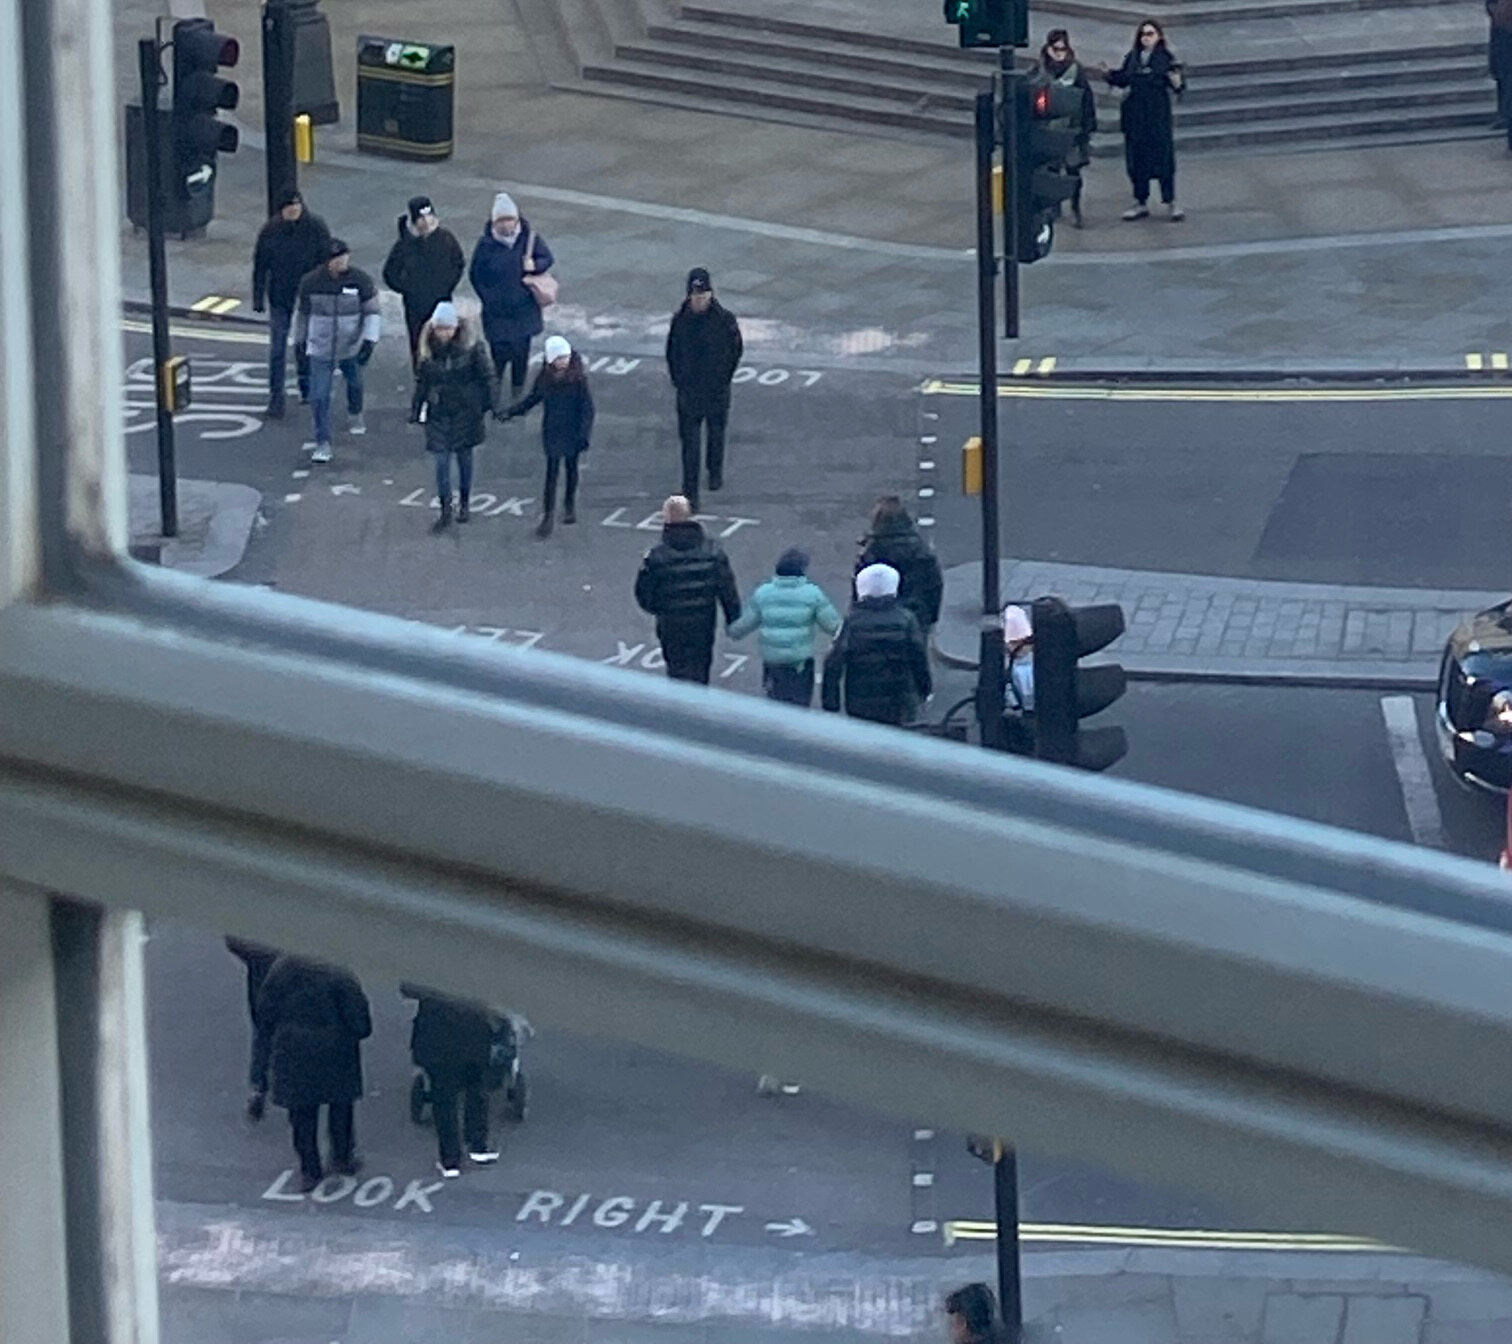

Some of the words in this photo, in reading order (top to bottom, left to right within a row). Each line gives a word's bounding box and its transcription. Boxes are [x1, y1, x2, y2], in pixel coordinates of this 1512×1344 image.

[731, 365, 823, 388] LOO
[262, 1169, 446, 1213] LOOK
[515, 1190, 745, 1238] RIGHT
